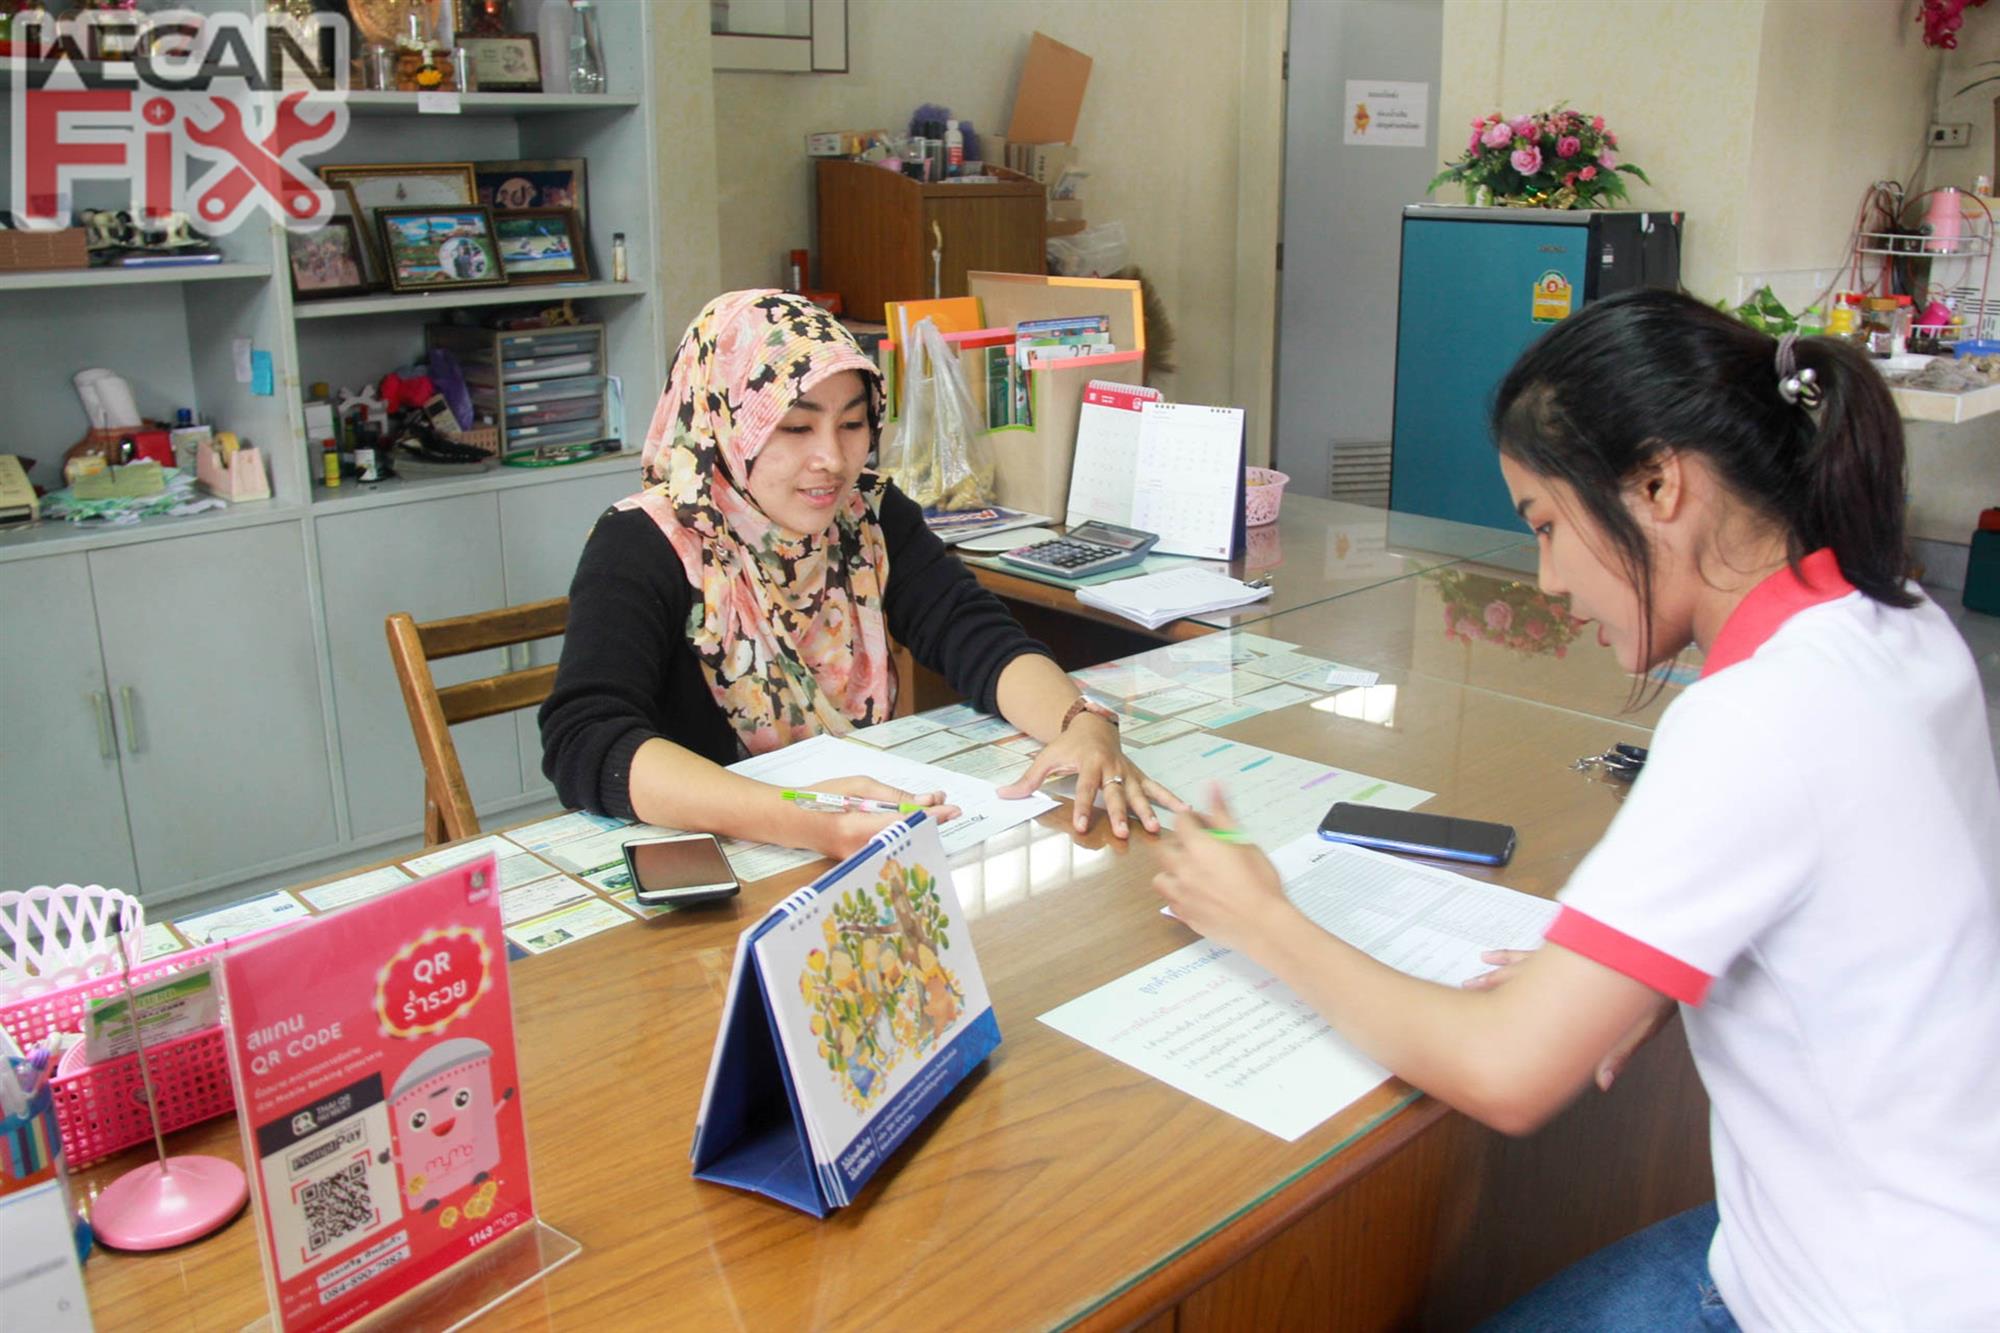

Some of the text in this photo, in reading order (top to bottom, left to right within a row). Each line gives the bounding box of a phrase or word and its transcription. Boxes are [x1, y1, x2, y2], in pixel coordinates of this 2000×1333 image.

[412, 951, 451, 984] QR
[403, 980, 468, 1020] ร่ำรวย
[247, 1014, 305, 1051] สแกน
[251, 1050, 281, 1076] QR
[287, 1022, 344, 1057] CODE
[468, 1225, 494, 1248] 1143
